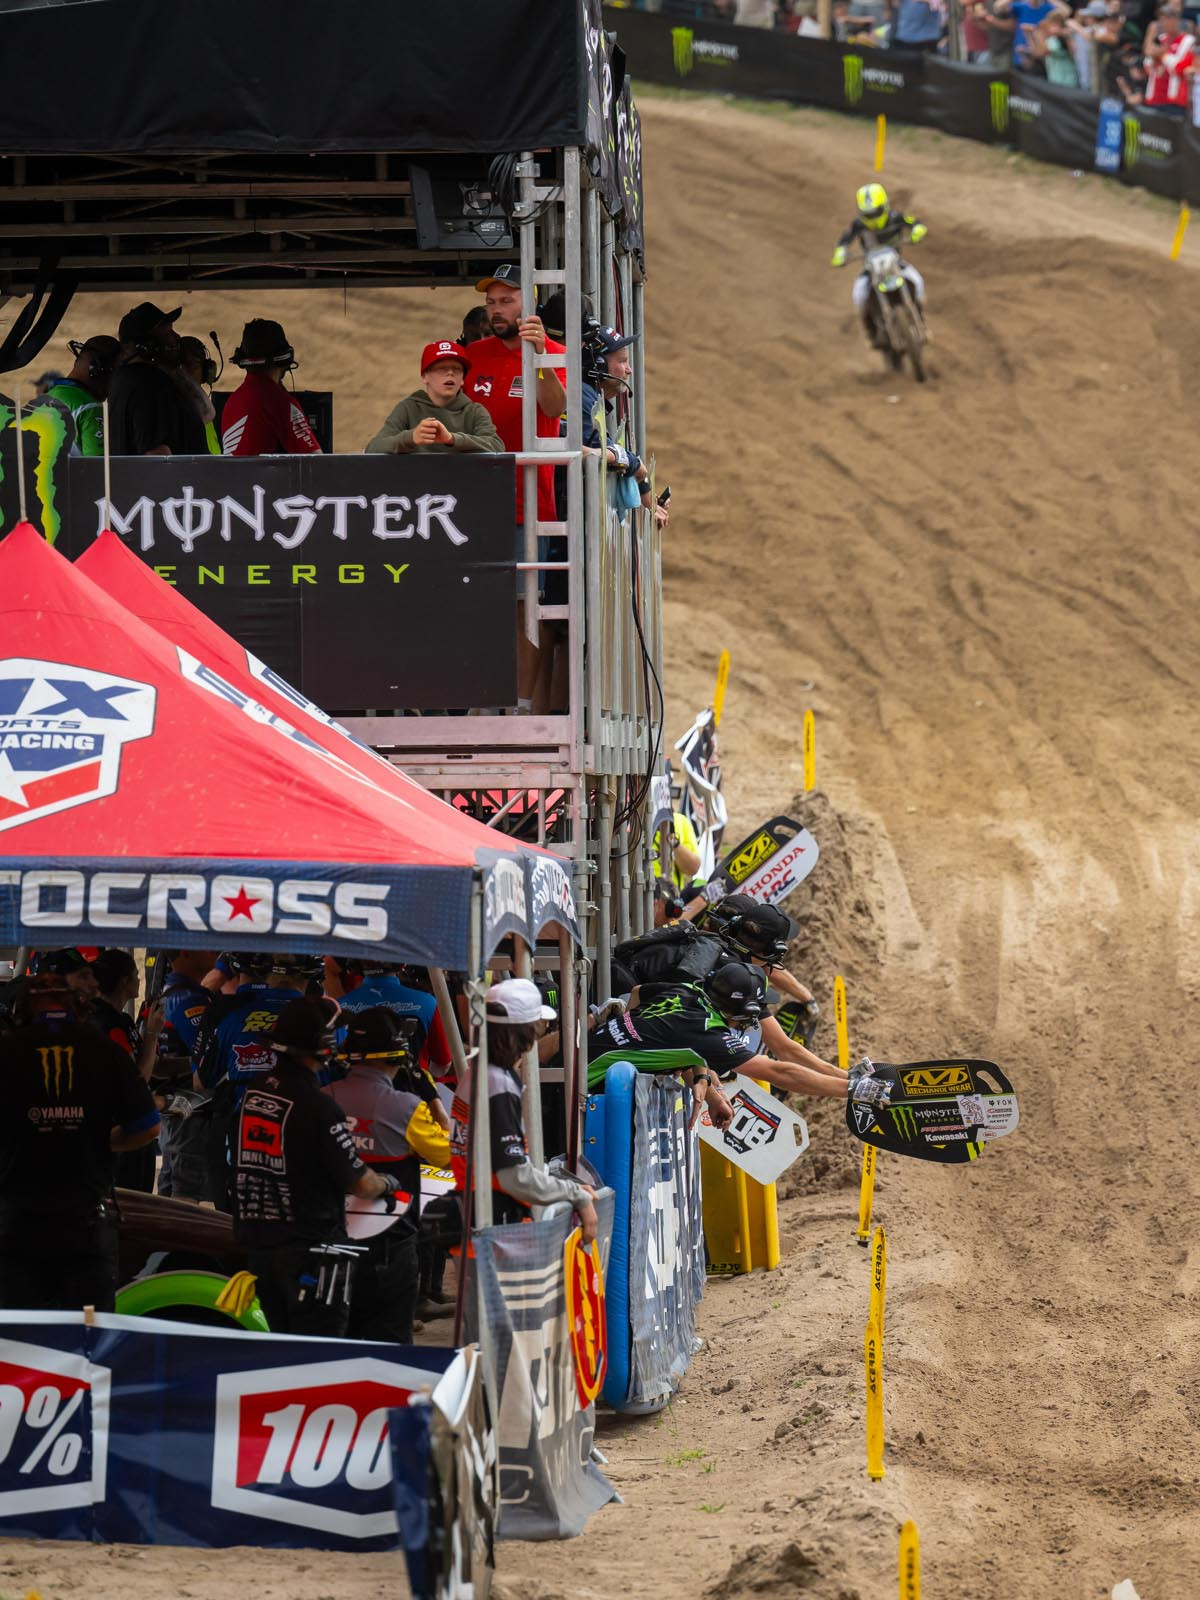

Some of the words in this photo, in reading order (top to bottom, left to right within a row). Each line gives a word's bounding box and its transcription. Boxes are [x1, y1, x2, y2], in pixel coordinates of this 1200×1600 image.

[95, 484, 469, 552] MONSTER
[155, 563, 410, 584] ENERGY
[0, 734, 95, 750] ACING
[749, 846, 806, 896] HONDA
[762, 869, 796, 903] HRC
[0, 871, 391, 941] OCROSS
[906, 1086, 948, 1096] MECHANIX
[949, 1083, 972, 1093] WEAR
[41, 1106, 84, 1119] YAMAHA
[925, 1133, 969, 1142] Kawasaki
[874, 1243, 883, 1291] ACERBIS
[868, 1340, 876, 1394] ACERBIS
